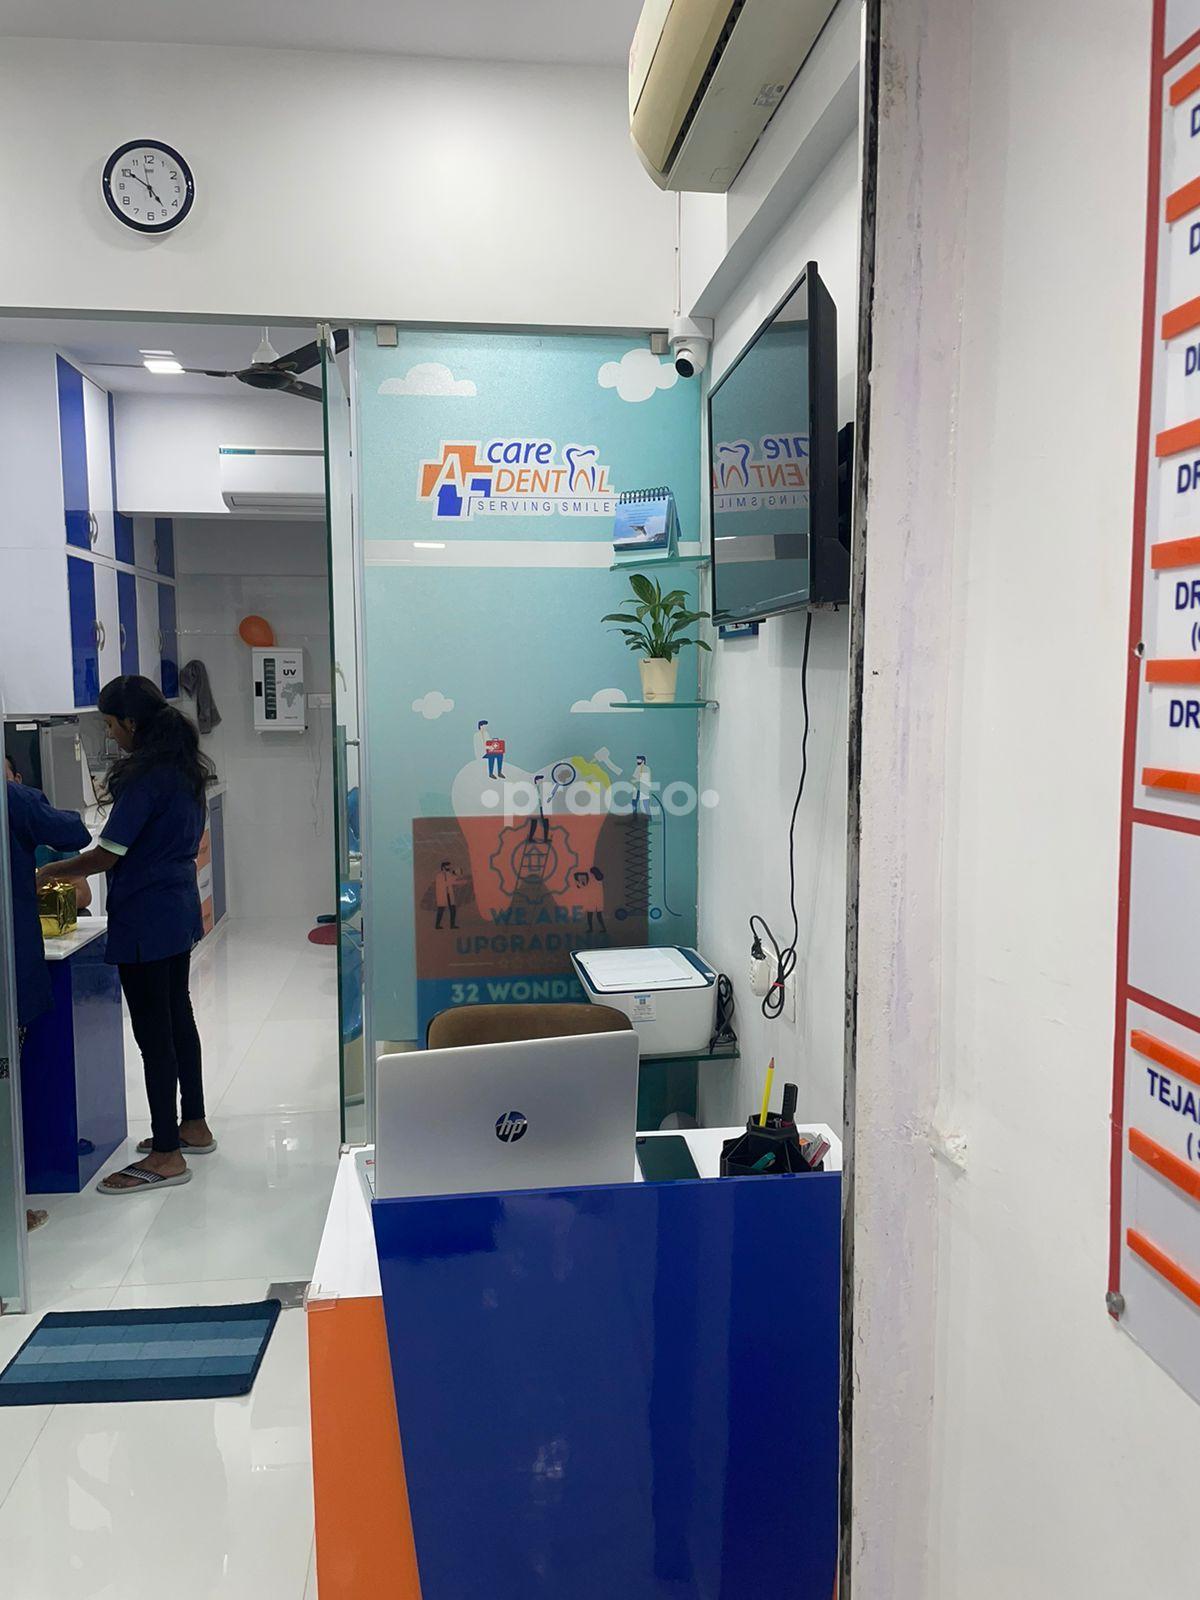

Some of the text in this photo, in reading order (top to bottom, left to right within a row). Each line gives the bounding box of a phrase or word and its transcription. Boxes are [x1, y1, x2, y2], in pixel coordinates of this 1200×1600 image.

[144, 155, 154, 164] 12
[121, 168, 131, 178] 10
[169, 170, 177, 180] 2
[119, 182, 125, 190] 9
[174, 185, 180, 193] 3
[122, 196, 130, 205] 8
[171, 199, 178, 207] 4
[133, 207, 139, 215] 7
[147, 211, 155, 221] 6
[161, 209, 167, 217] 5
[1185, 342, 1200, 376] D
[487, 442, 552, 464] care
[477, 501, 617, 513] SERVING SMILE
[491, 905, 584, 926] WE ARE
[451, 983, 479, 1003] 32
[1147, 1067, 1200, 1125] TEJA
[495, 1111, 528, 1143] hp
